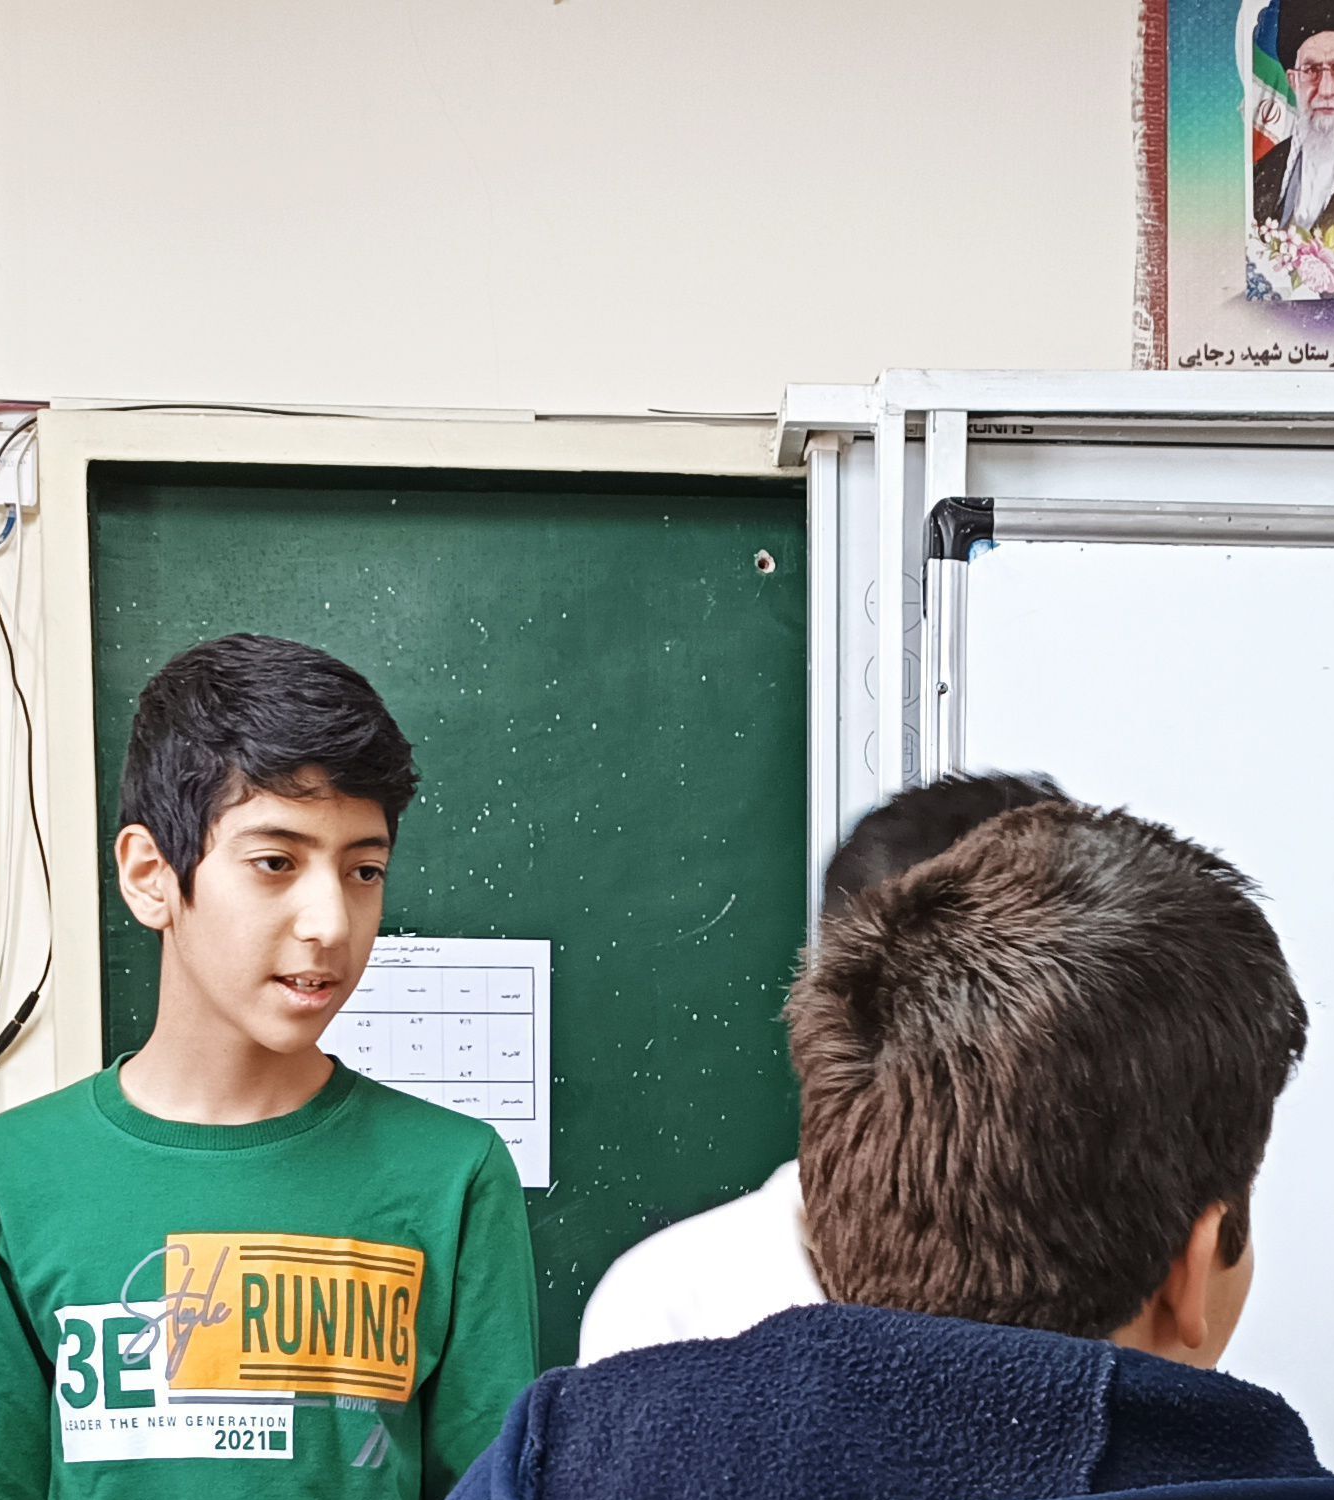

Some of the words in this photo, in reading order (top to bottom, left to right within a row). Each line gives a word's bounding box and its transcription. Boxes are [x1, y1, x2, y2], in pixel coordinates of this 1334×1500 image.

[1177, 342, 1235, 369] رجایی
[1240, 342, 1283, 367] شهید
[120, 1243, 232, 1381] Style
[241, 1272, 410, 1367] RUNING
[59, 1316, 156, 1410] 3E
[335, 1395, 378, 1413] MOVING
[110, 1417, 140, 1429] THE
[147, 1416, 177, 1428] NEW
[185, 1415, 288, 1428] GENERATION
[214, 1429, 268, 1451] 2021
